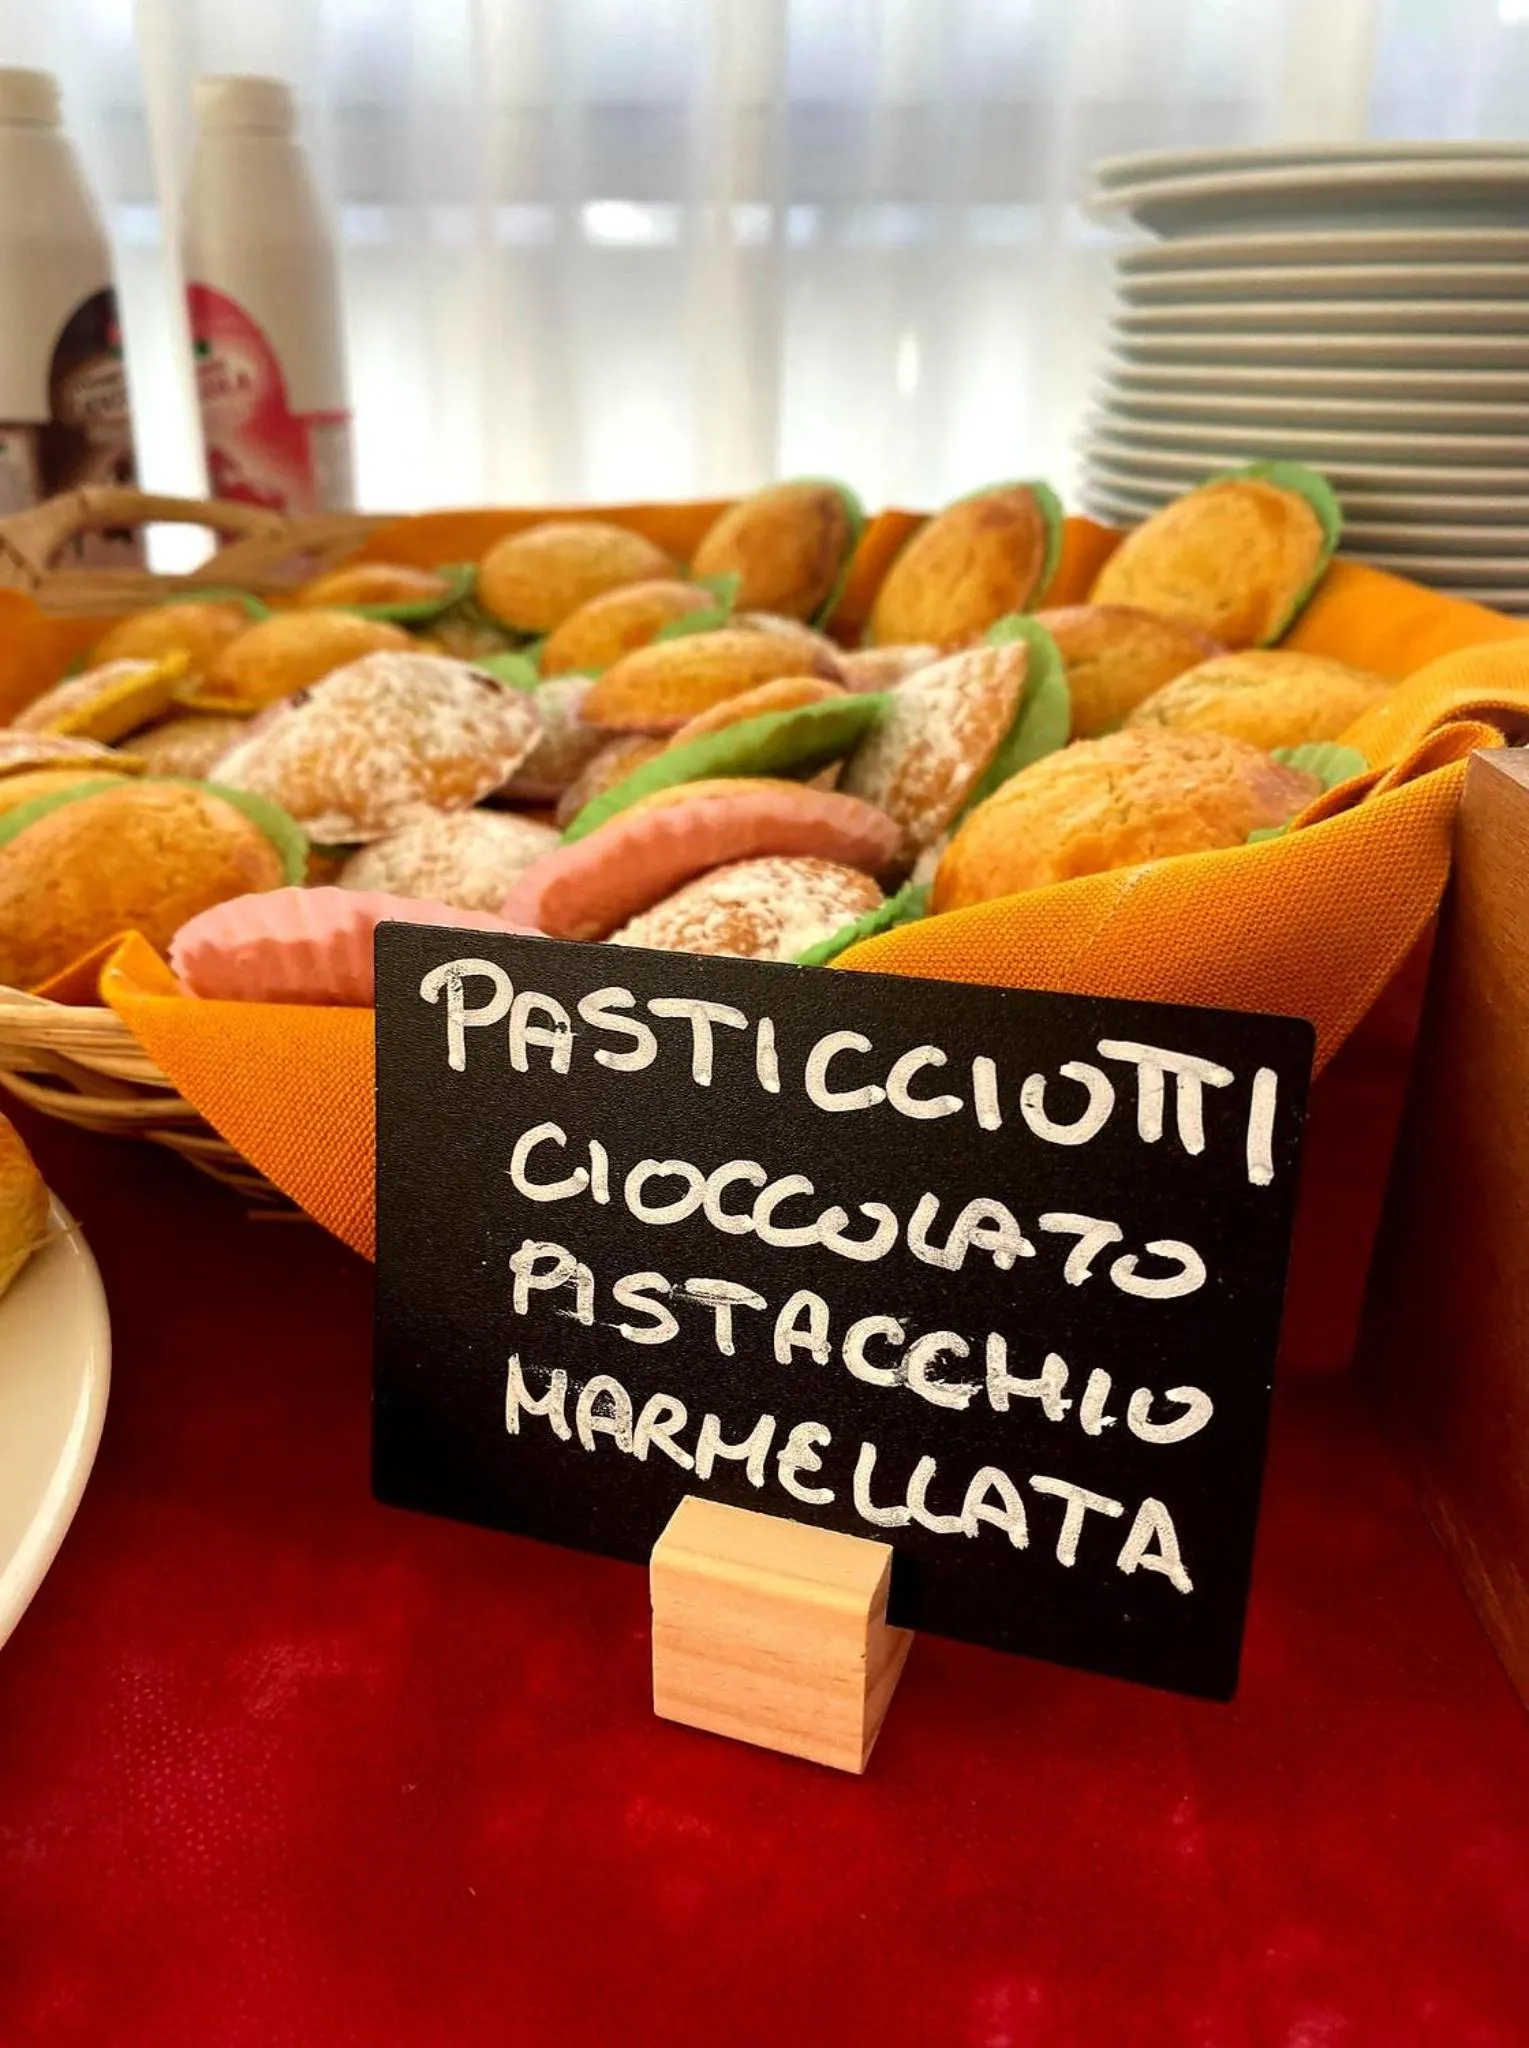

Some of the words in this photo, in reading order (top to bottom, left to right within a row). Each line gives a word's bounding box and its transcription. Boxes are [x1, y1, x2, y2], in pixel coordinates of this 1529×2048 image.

[420, 957, 1278, 1187] PASTICCIOTTI
[507, 1121, 1207, 1301] CIOCCOLATO
[508, 1239, 1215, 1445] PISTACCHIO
[505, 1352, 1194, 1595] MARMELLATA
